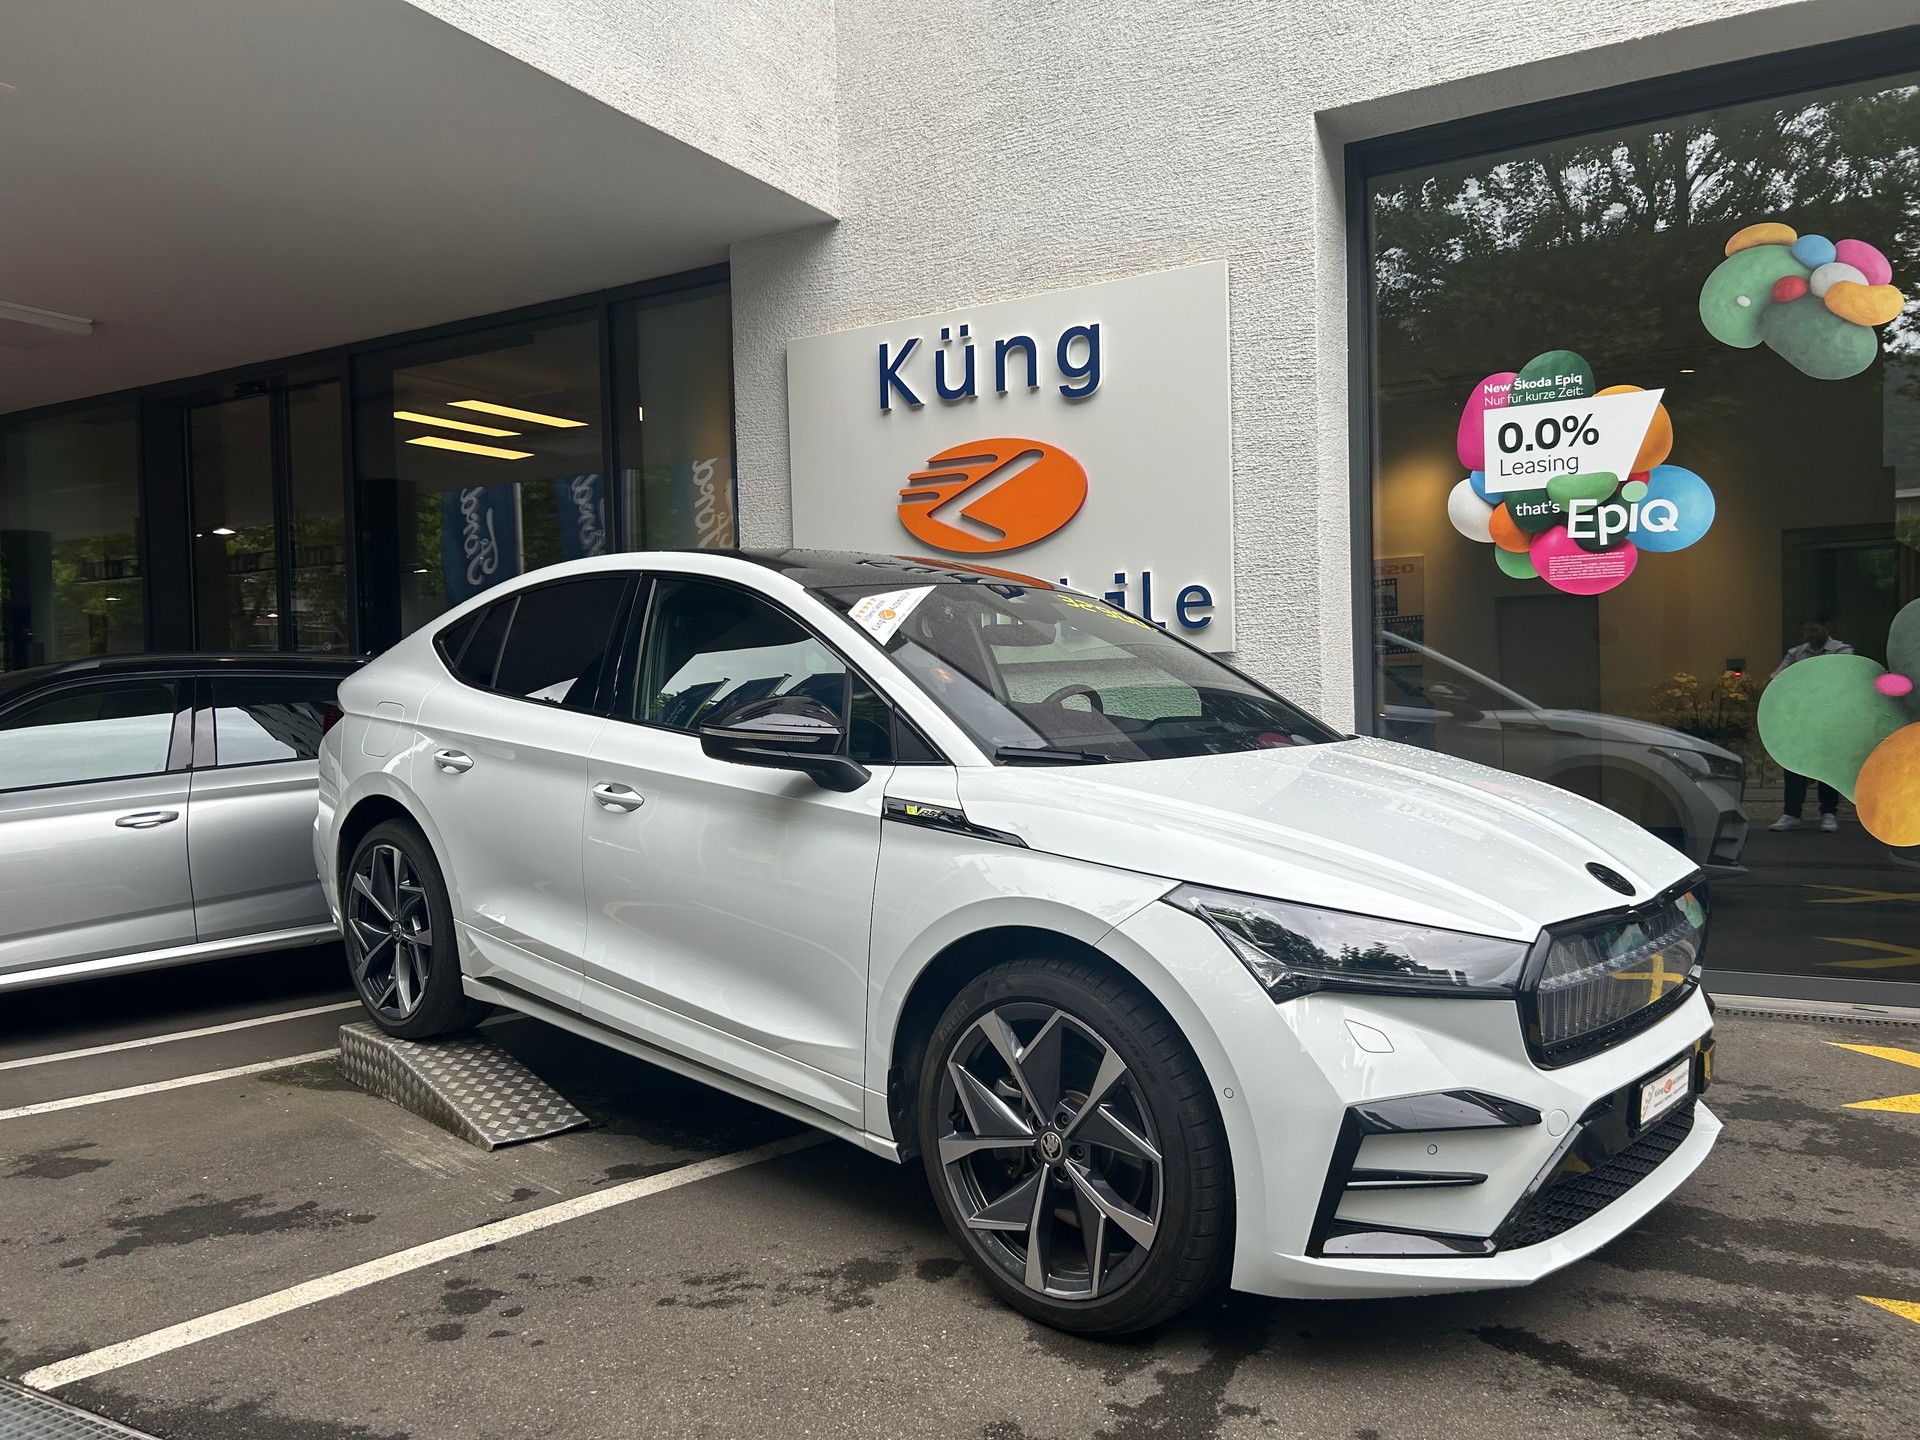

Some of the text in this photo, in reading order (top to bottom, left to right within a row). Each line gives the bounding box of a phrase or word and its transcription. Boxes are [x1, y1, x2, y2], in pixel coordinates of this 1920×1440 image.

[879, 322, 1102, 410] Küng
[1484, 374, 1582, 394] New Škoda Epiq
[1484, 386, 1584, 407] Nur für kurze Zeit:
[1498, 413, 1599, 453] 0.0%
[1500, 454, 1578, 477] Leasing
[1515, 501, 1560, 516] that's
